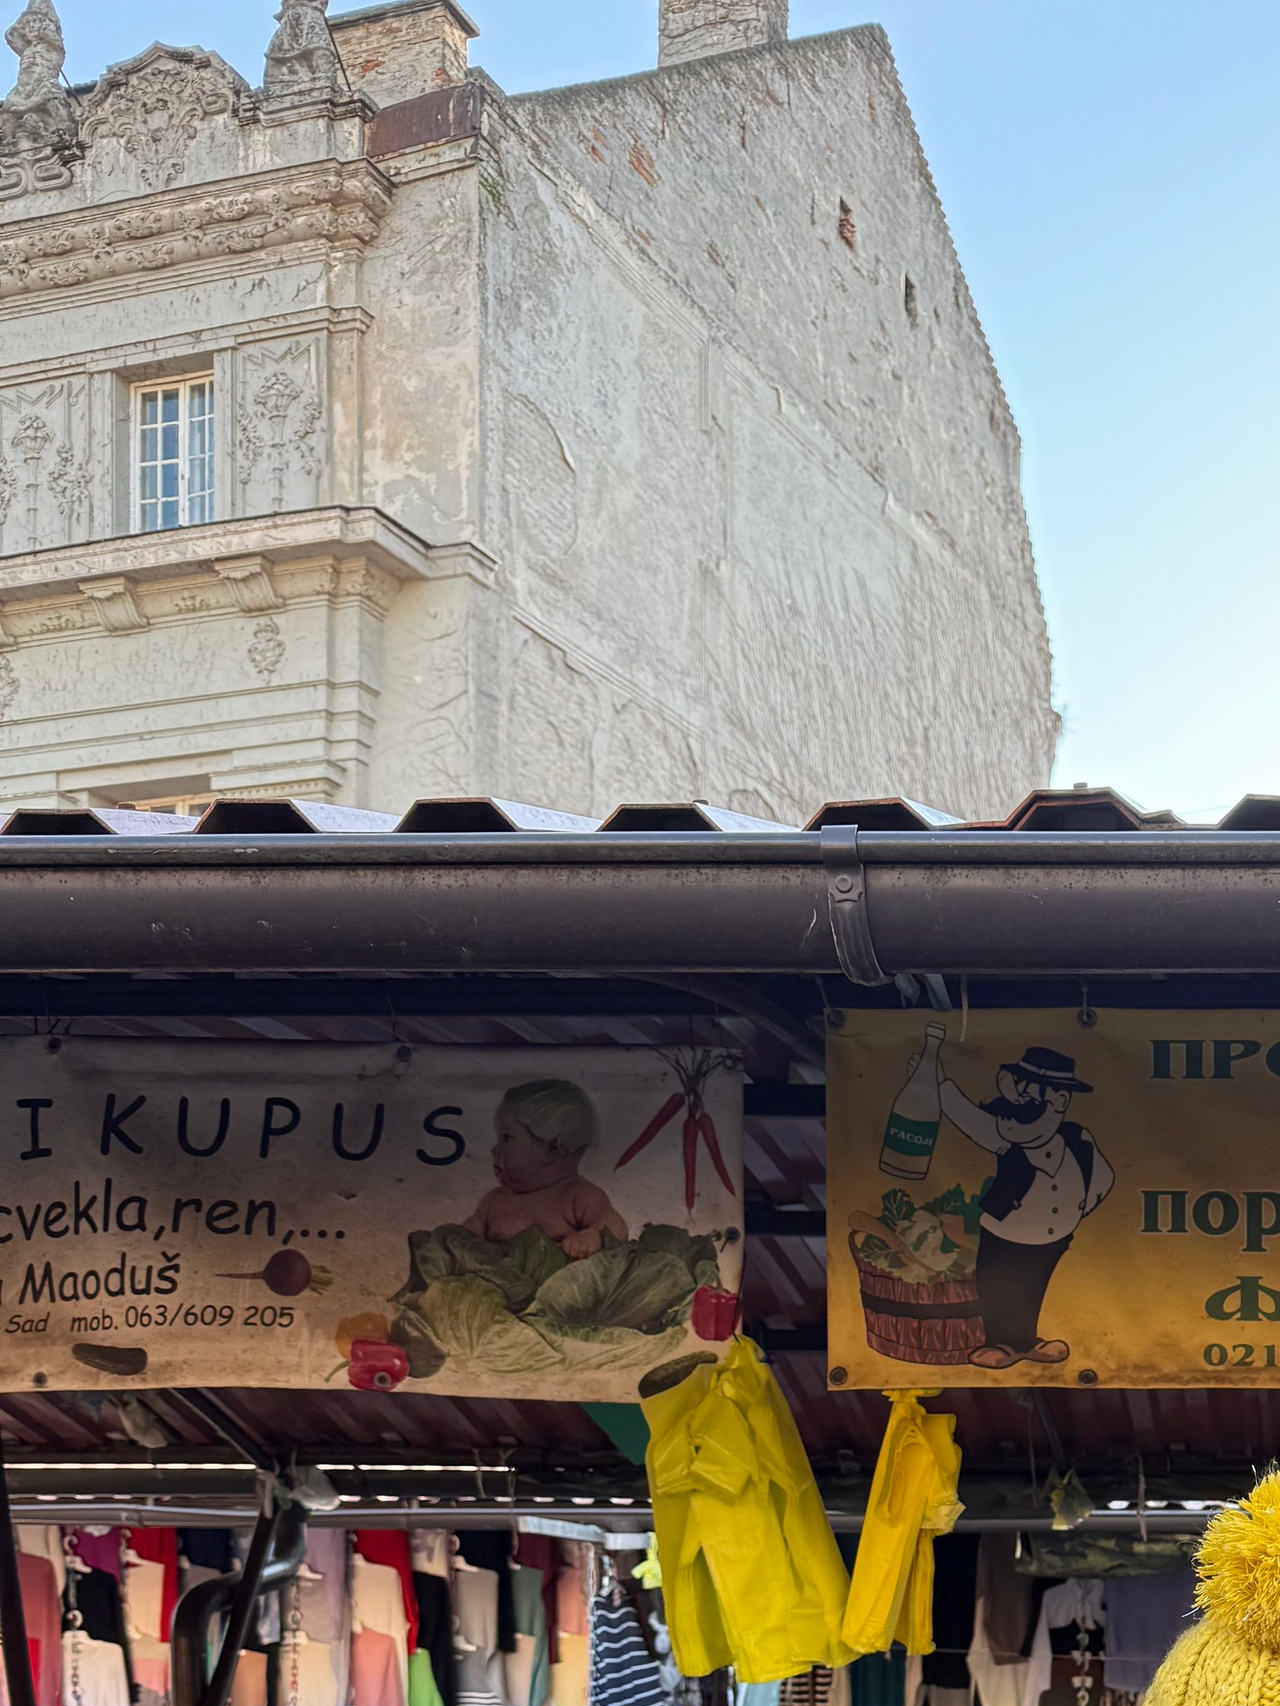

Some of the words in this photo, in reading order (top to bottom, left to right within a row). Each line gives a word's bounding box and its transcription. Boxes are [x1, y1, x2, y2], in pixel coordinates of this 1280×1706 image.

[100, 1093, 467, 1166] KUPUS
[889, 1126, 933, 1147] РАСОЛ
[18, 1250, 181, 1305] Maoduš
[5, 1311, 50, 1334] Sad
[70, 1308, 119, 1332] mob.
[124, 1303, 233, 1328] 063/609
[243, 1305, 295, 1329] 205
